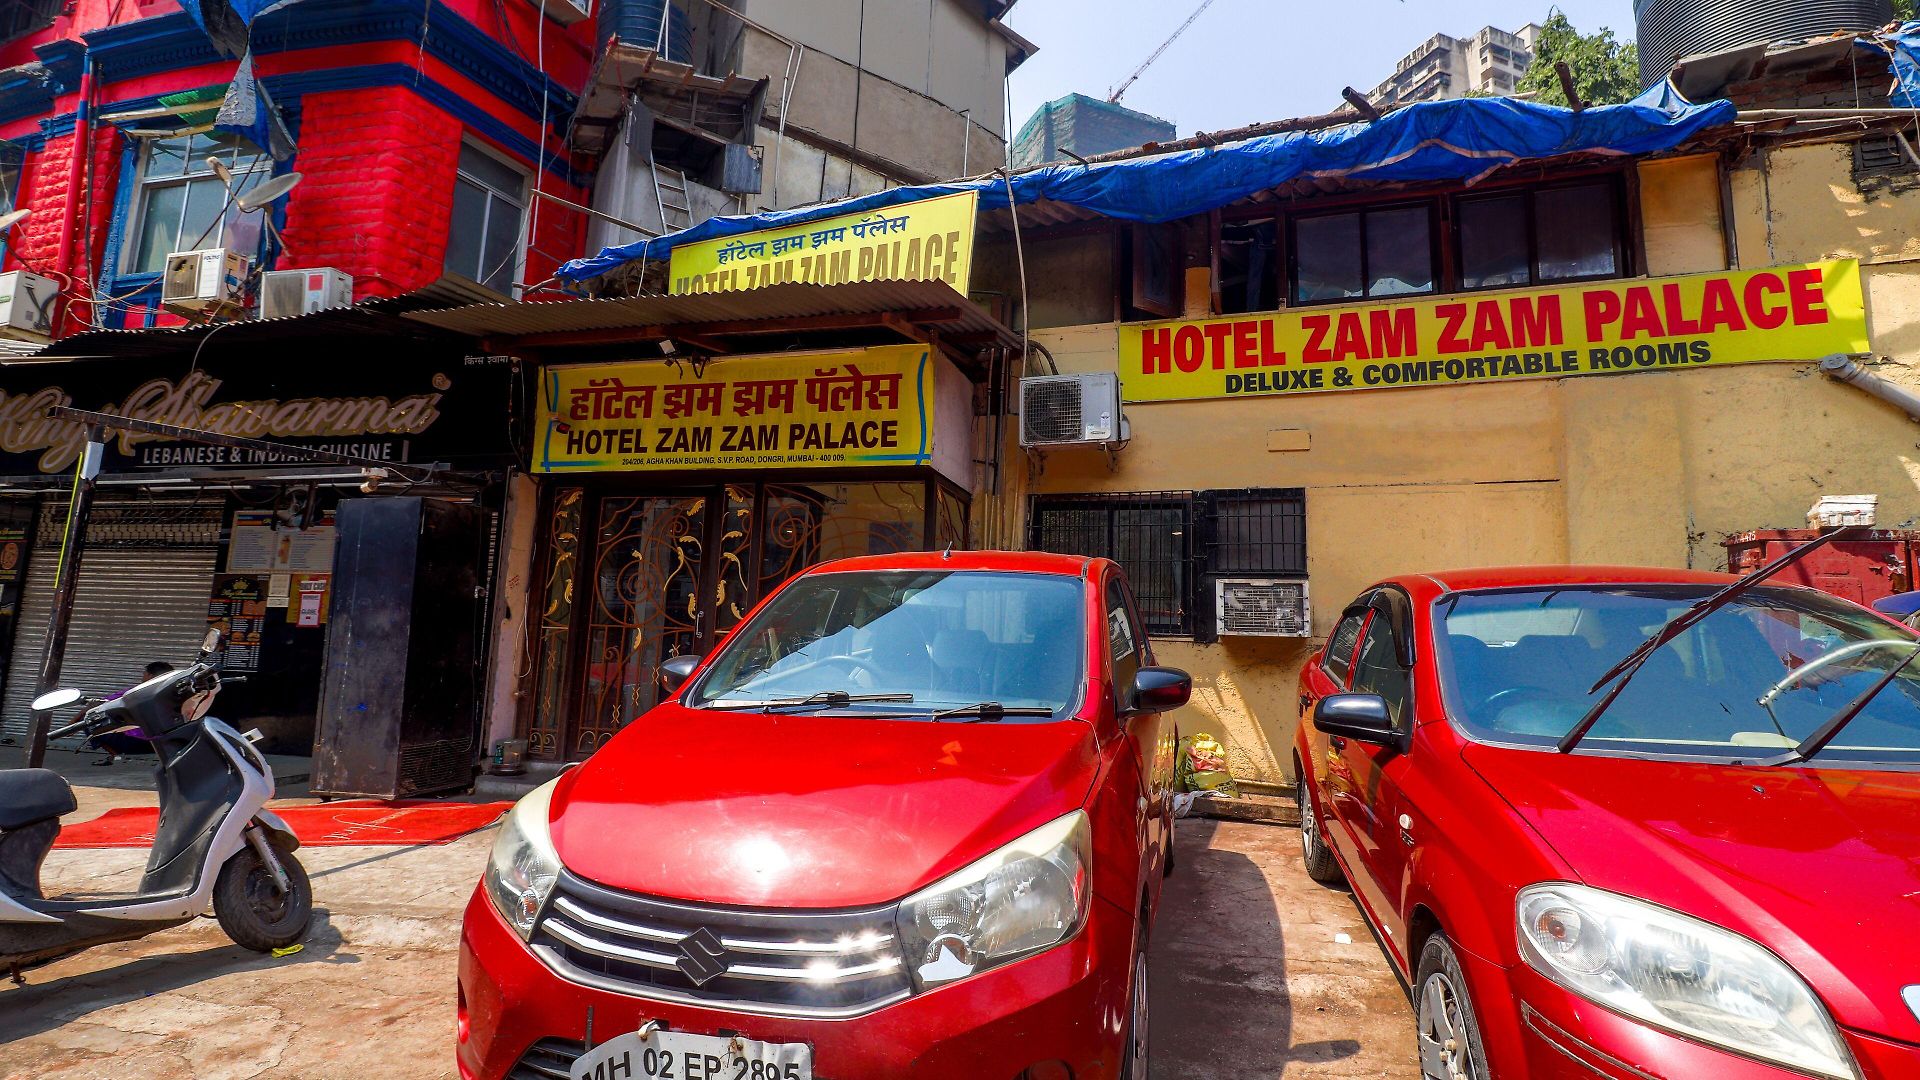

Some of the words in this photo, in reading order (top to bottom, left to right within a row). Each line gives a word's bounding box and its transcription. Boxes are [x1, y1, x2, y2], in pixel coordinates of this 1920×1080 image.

[717, 241, 765, 265] हॉटेल
[771, 235, 805, 257] झम
[811, 227, 847, 249] झम
[851, 214, 910, 239] पॅलेस
[858, 231, 960, 284] PALACE
[1142, 320, 1286, 374] HOTEL
[1301, 307, 1418, 363] ZAM
[1435, 295, 1563, 354] ZAM
[1583, 268, 1829, 342] PALACE
[569, 377, 656, 421] हॉटेल
[663, 382, 726, 419] झम
[732, 378, 799, 417] झम
[805, 364, 903, 414] पॅलेस
[1225, 367, 1324, 393] DELUXE
[1333, 365, 1353, 387] &
[1362, 351, 1579, 385] COMFORTABLE
[1589, 340, 1711, 370] ROOMS
[116, 370, 442, 455] Shawarma
[566, 428, 647, 454] HOTEL
[656, 425, 712, 453] ZAM
[720, 423, 779, 451] ZAM
[788, 420, 898, 450] PALACE
[143, 447, 225, 464] LEBANESE
[229, 447, 242, 463] &
[646, 457, 664, 465] AGHA
[665, 457, 684, 465] KHAN
[684, 456, 716, 466] BUILDING,
[735, 456, 756, 465] ROAD,
[757, 455, 786, 464] DONGRI,
[787, 454, 815, 463] MUMBAI
[820, 454, 831, 462] 400
[582, 1051, 631, 1080] MH
[643, 1048, 674, 1078] 02
[685, 1053, 721, 1080] EP
[732, 1057, 799, 1080] 2895
